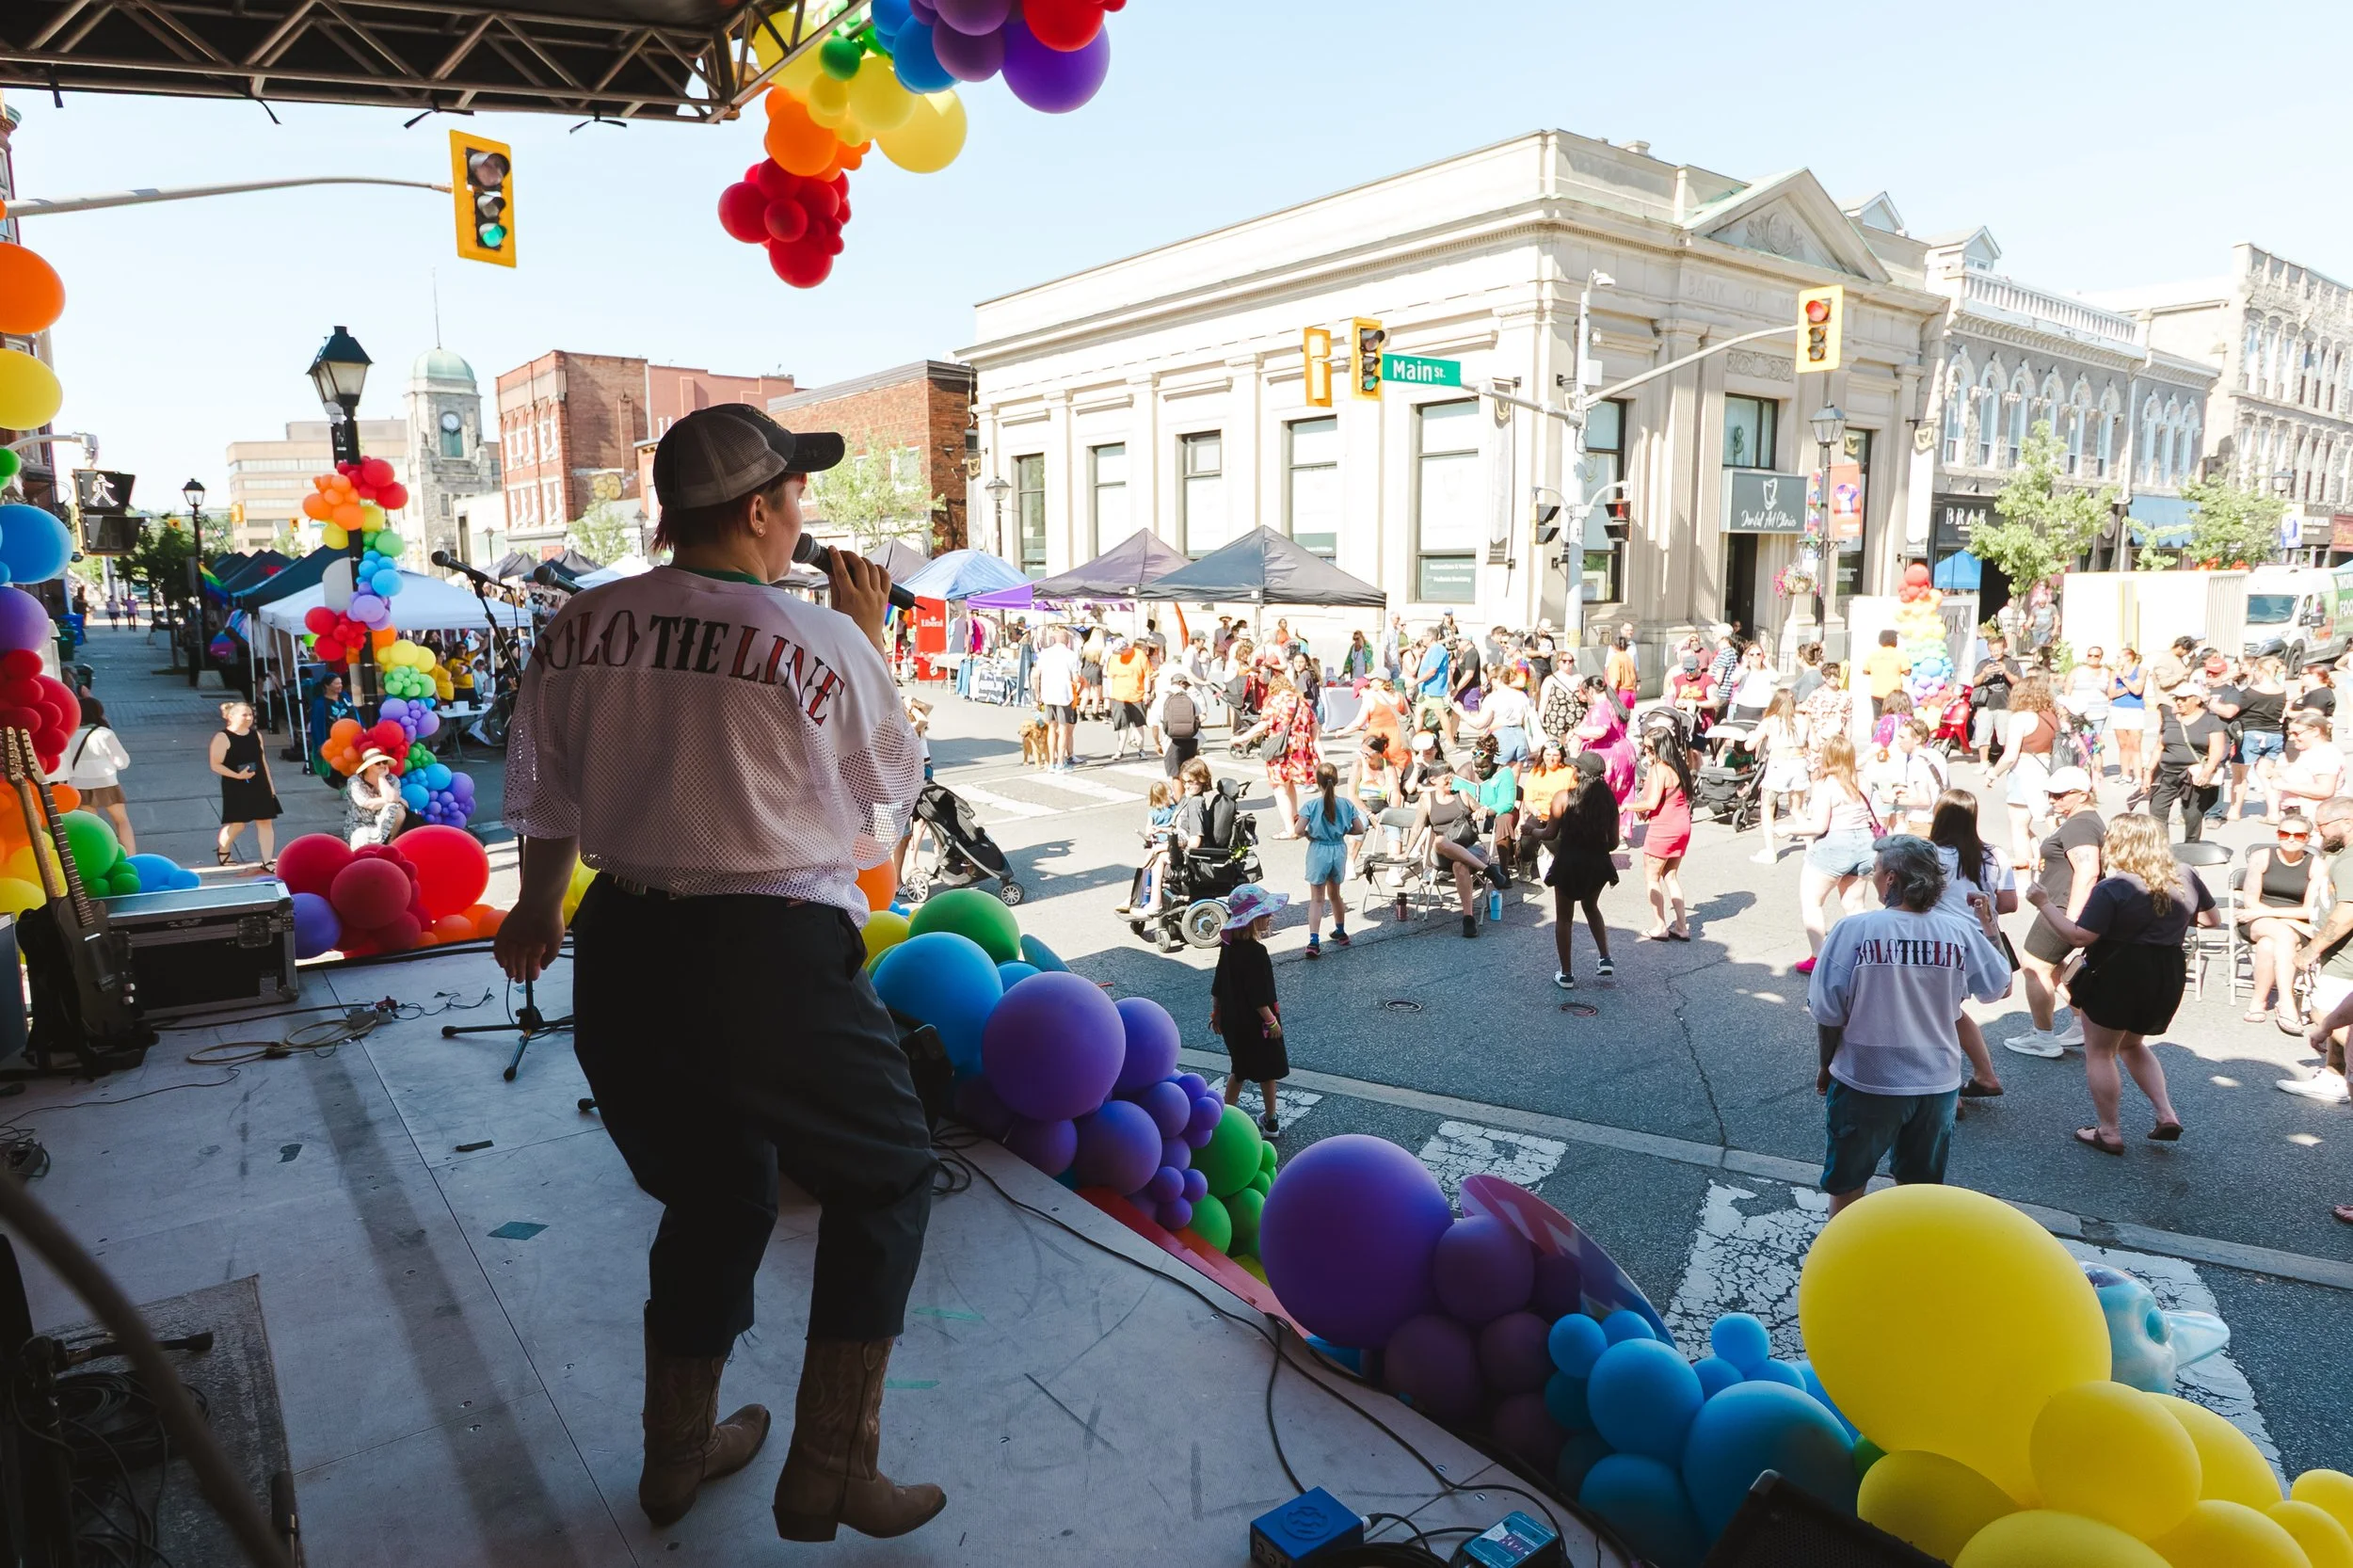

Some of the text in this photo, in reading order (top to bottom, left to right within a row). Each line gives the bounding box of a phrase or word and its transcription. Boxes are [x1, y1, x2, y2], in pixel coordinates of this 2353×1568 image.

[1688, 275, 1726, 301] BANK
[1743, 288, 1765, 311] OF
[1393, 360, 1446, 381] Main St.
[648, 615, 729, 674] TIE
[728, 625, 845, 727] LINE
